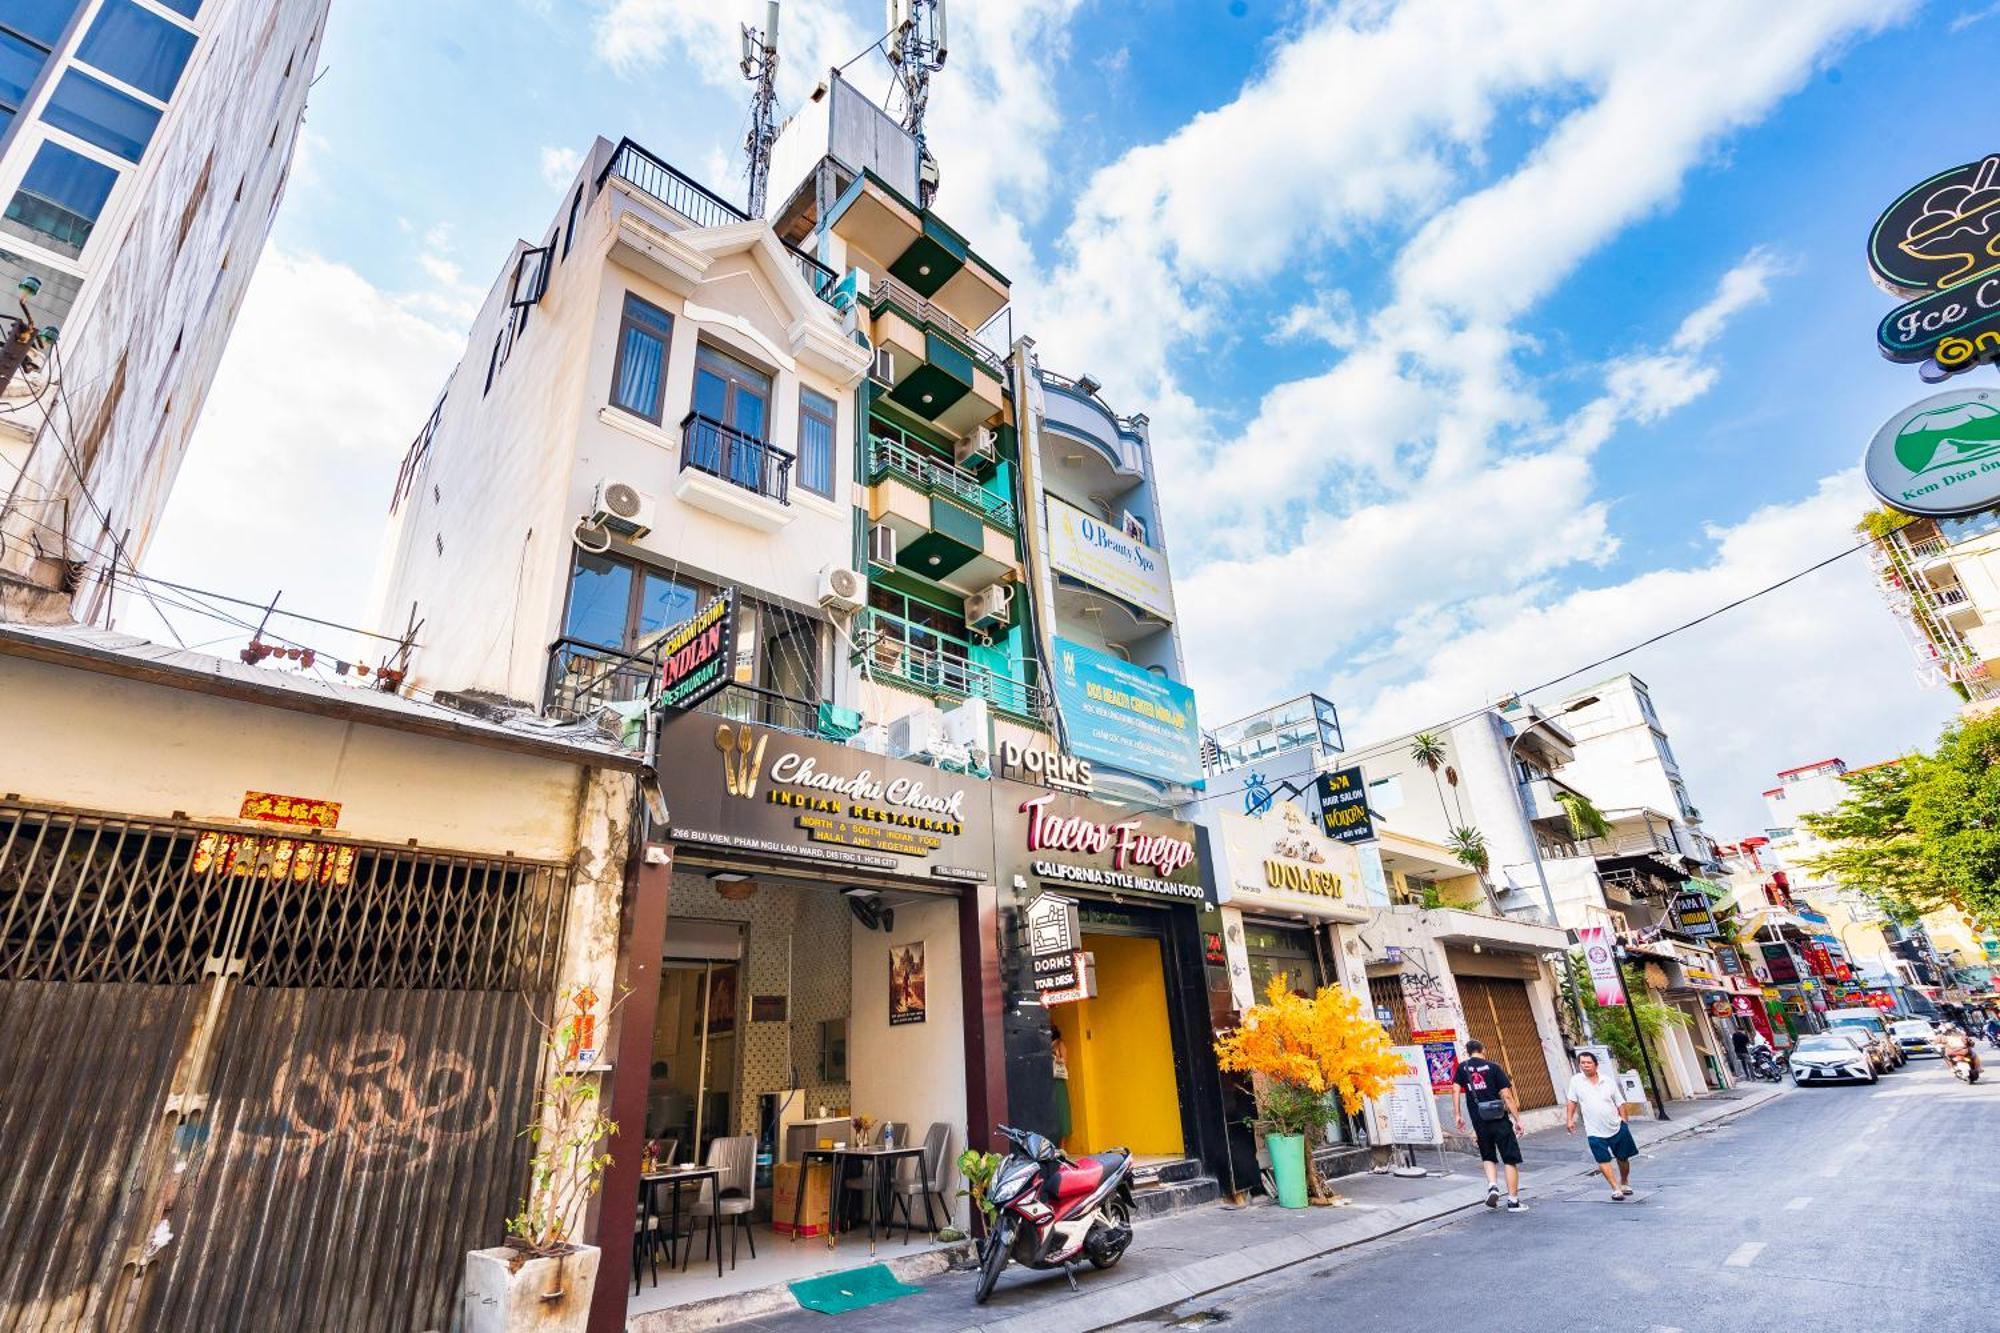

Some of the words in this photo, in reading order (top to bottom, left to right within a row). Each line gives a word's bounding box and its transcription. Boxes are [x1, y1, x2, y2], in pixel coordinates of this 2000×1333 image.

[1897, 303, 1968, 342] Ice
[1902, 482, 1939, 500] Kem
[1134, 546, 1155, 573] Spa
[661, 622, 721, 690] INDIAN
[662, 658, 721, 705] RESTAURANT
[1004, 740, 1093, 784] DORMS
[1329, 775, 1350, 792] SPA
[885, 778, 965, 822] Chowk
[1322, 796, 1339, 808] HAIR
[1340, 789, 1364, 803] SALON
[771, 791, 842, 814] INDIAN
[854, 805, 965, 836] RESTAURANT
[800, 815, 833, 829] NORTH
[853, 825, 881, 837] SOUTH
[672, 828, 690, 839] 266
[691, 831, 707, 842] BUI
[733, 836, 759, 849] PHAM
[760, 839, 780, 850] NGU
[780, 842, 798, 852] LAO
[816, 831, 845, 842] HALAL
[853, 837, 871, 847] AND
[1019, 793, 1111, 853] Tacos
[1110, 820, 1195, 877] Fuego
[1035, 861, 1103, 885] CALIFORNIA
[1104, 873, 1134, 890] STYLE
[1135, 878, 1178, 897] MEXICAN
[1178, 883, 1205, 898] FOOD
[1034, 955, 1072, 972] DORMS
[1034, 978, 1055, 990] TOUR
[1055, 972, 1075, 986] DESK
